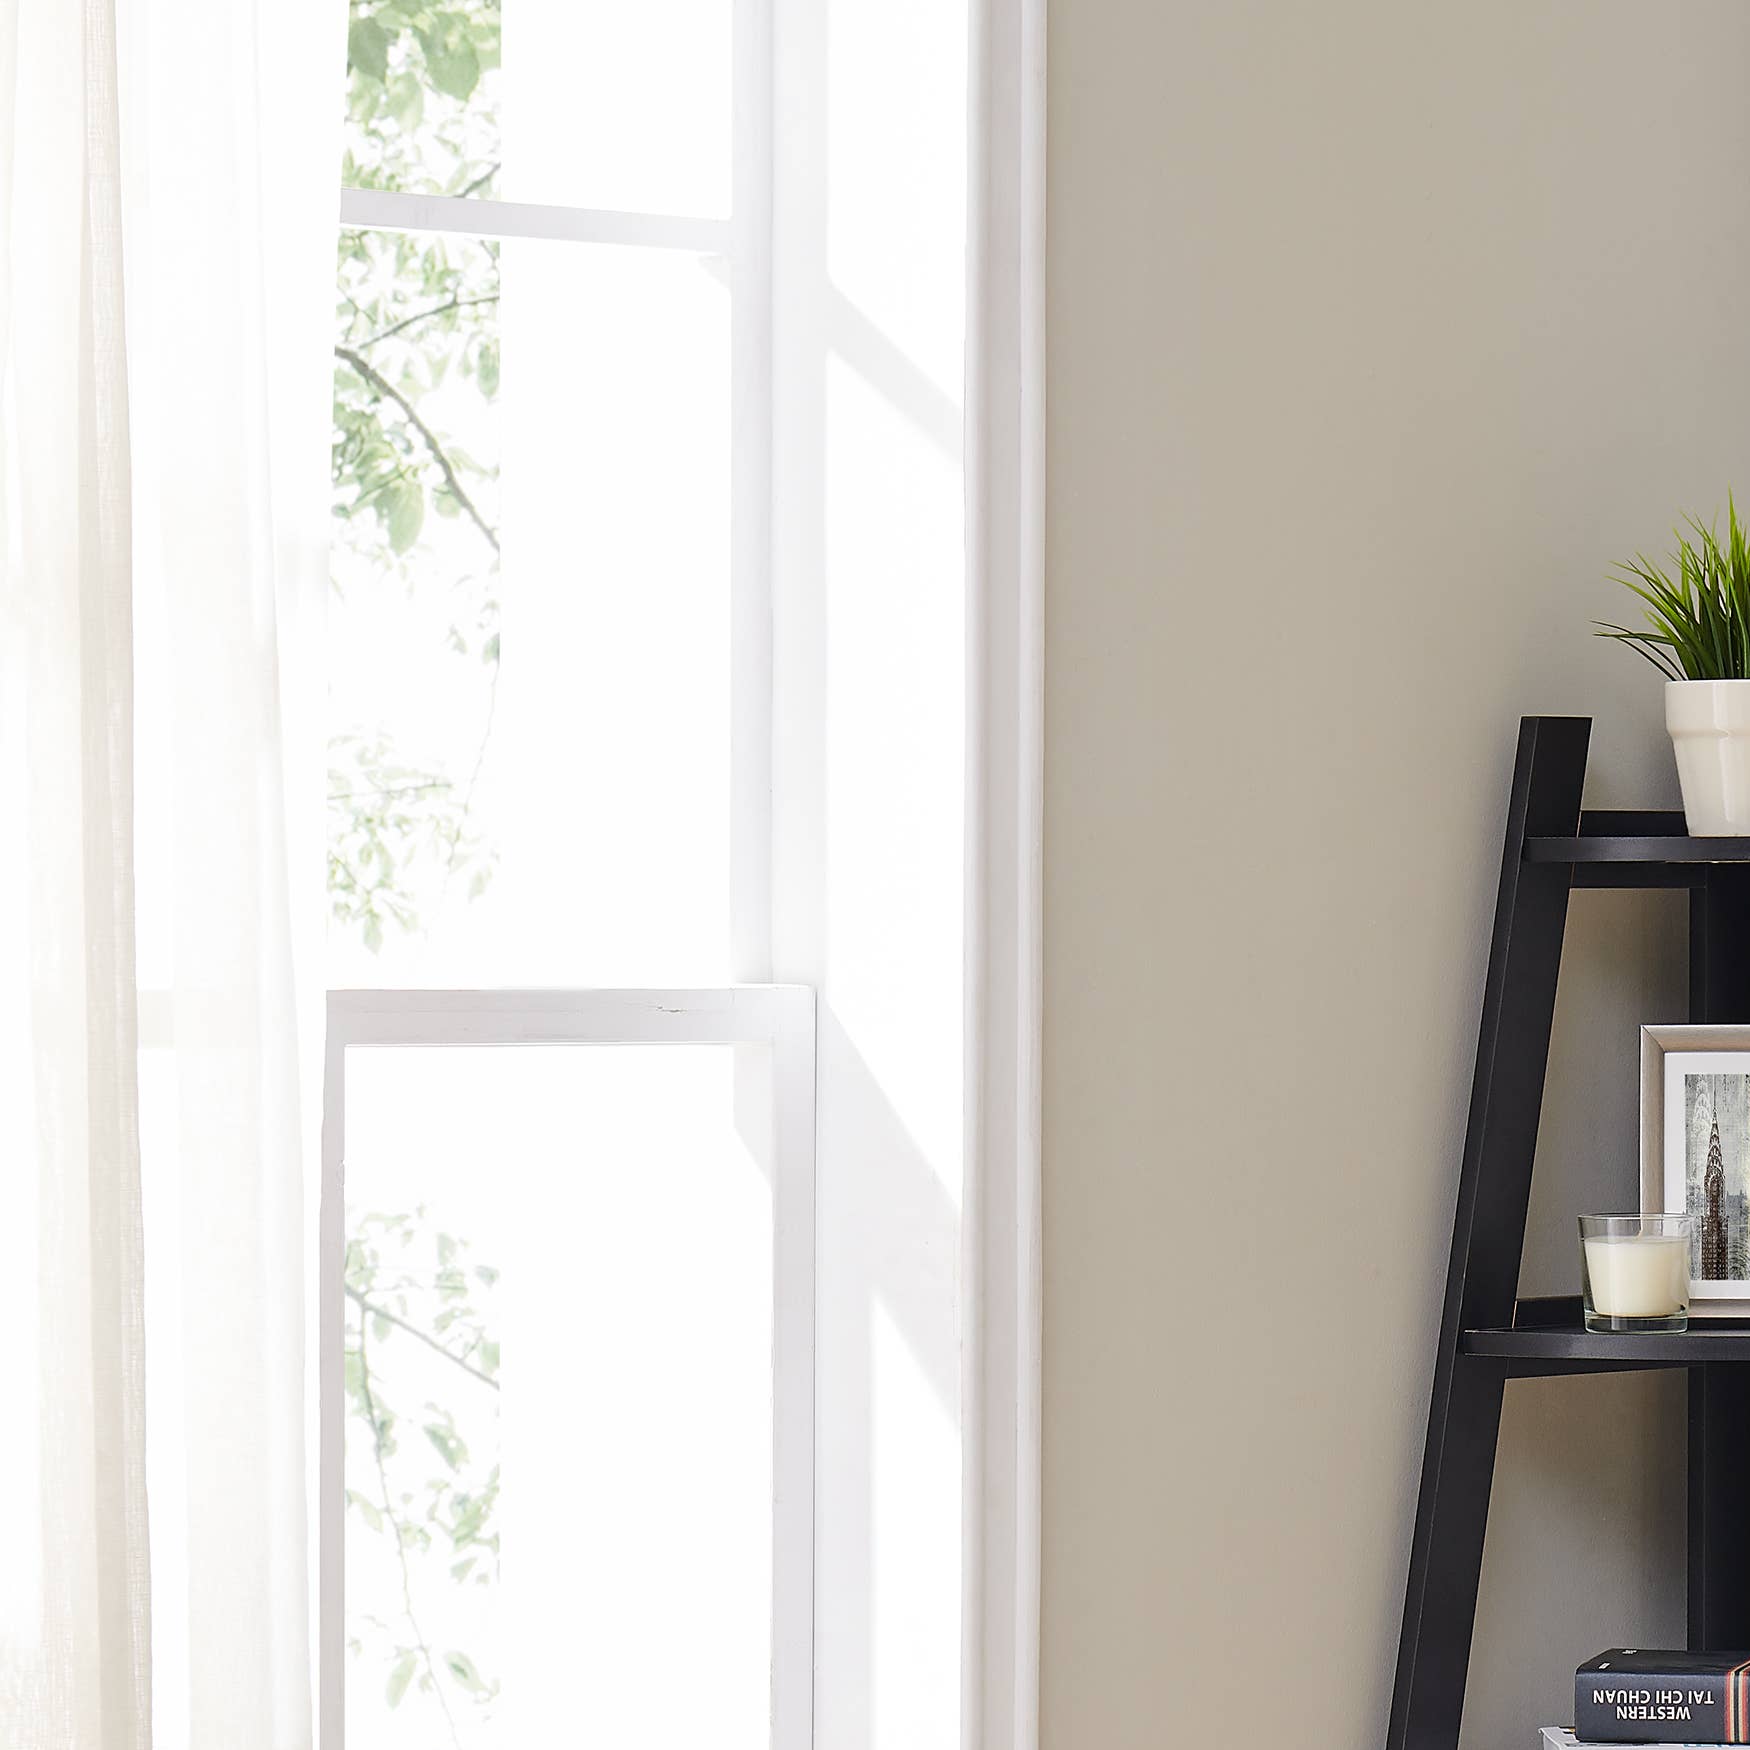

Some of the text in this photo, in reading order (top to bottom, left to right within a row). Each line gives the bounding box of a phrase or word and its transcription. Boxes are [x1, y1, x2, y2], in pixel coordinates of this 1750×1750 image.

[1593, 1689, 1715, 1704] TAI CHI CHUAN
[1616, 1706, 1691, 1720] WESTERN
